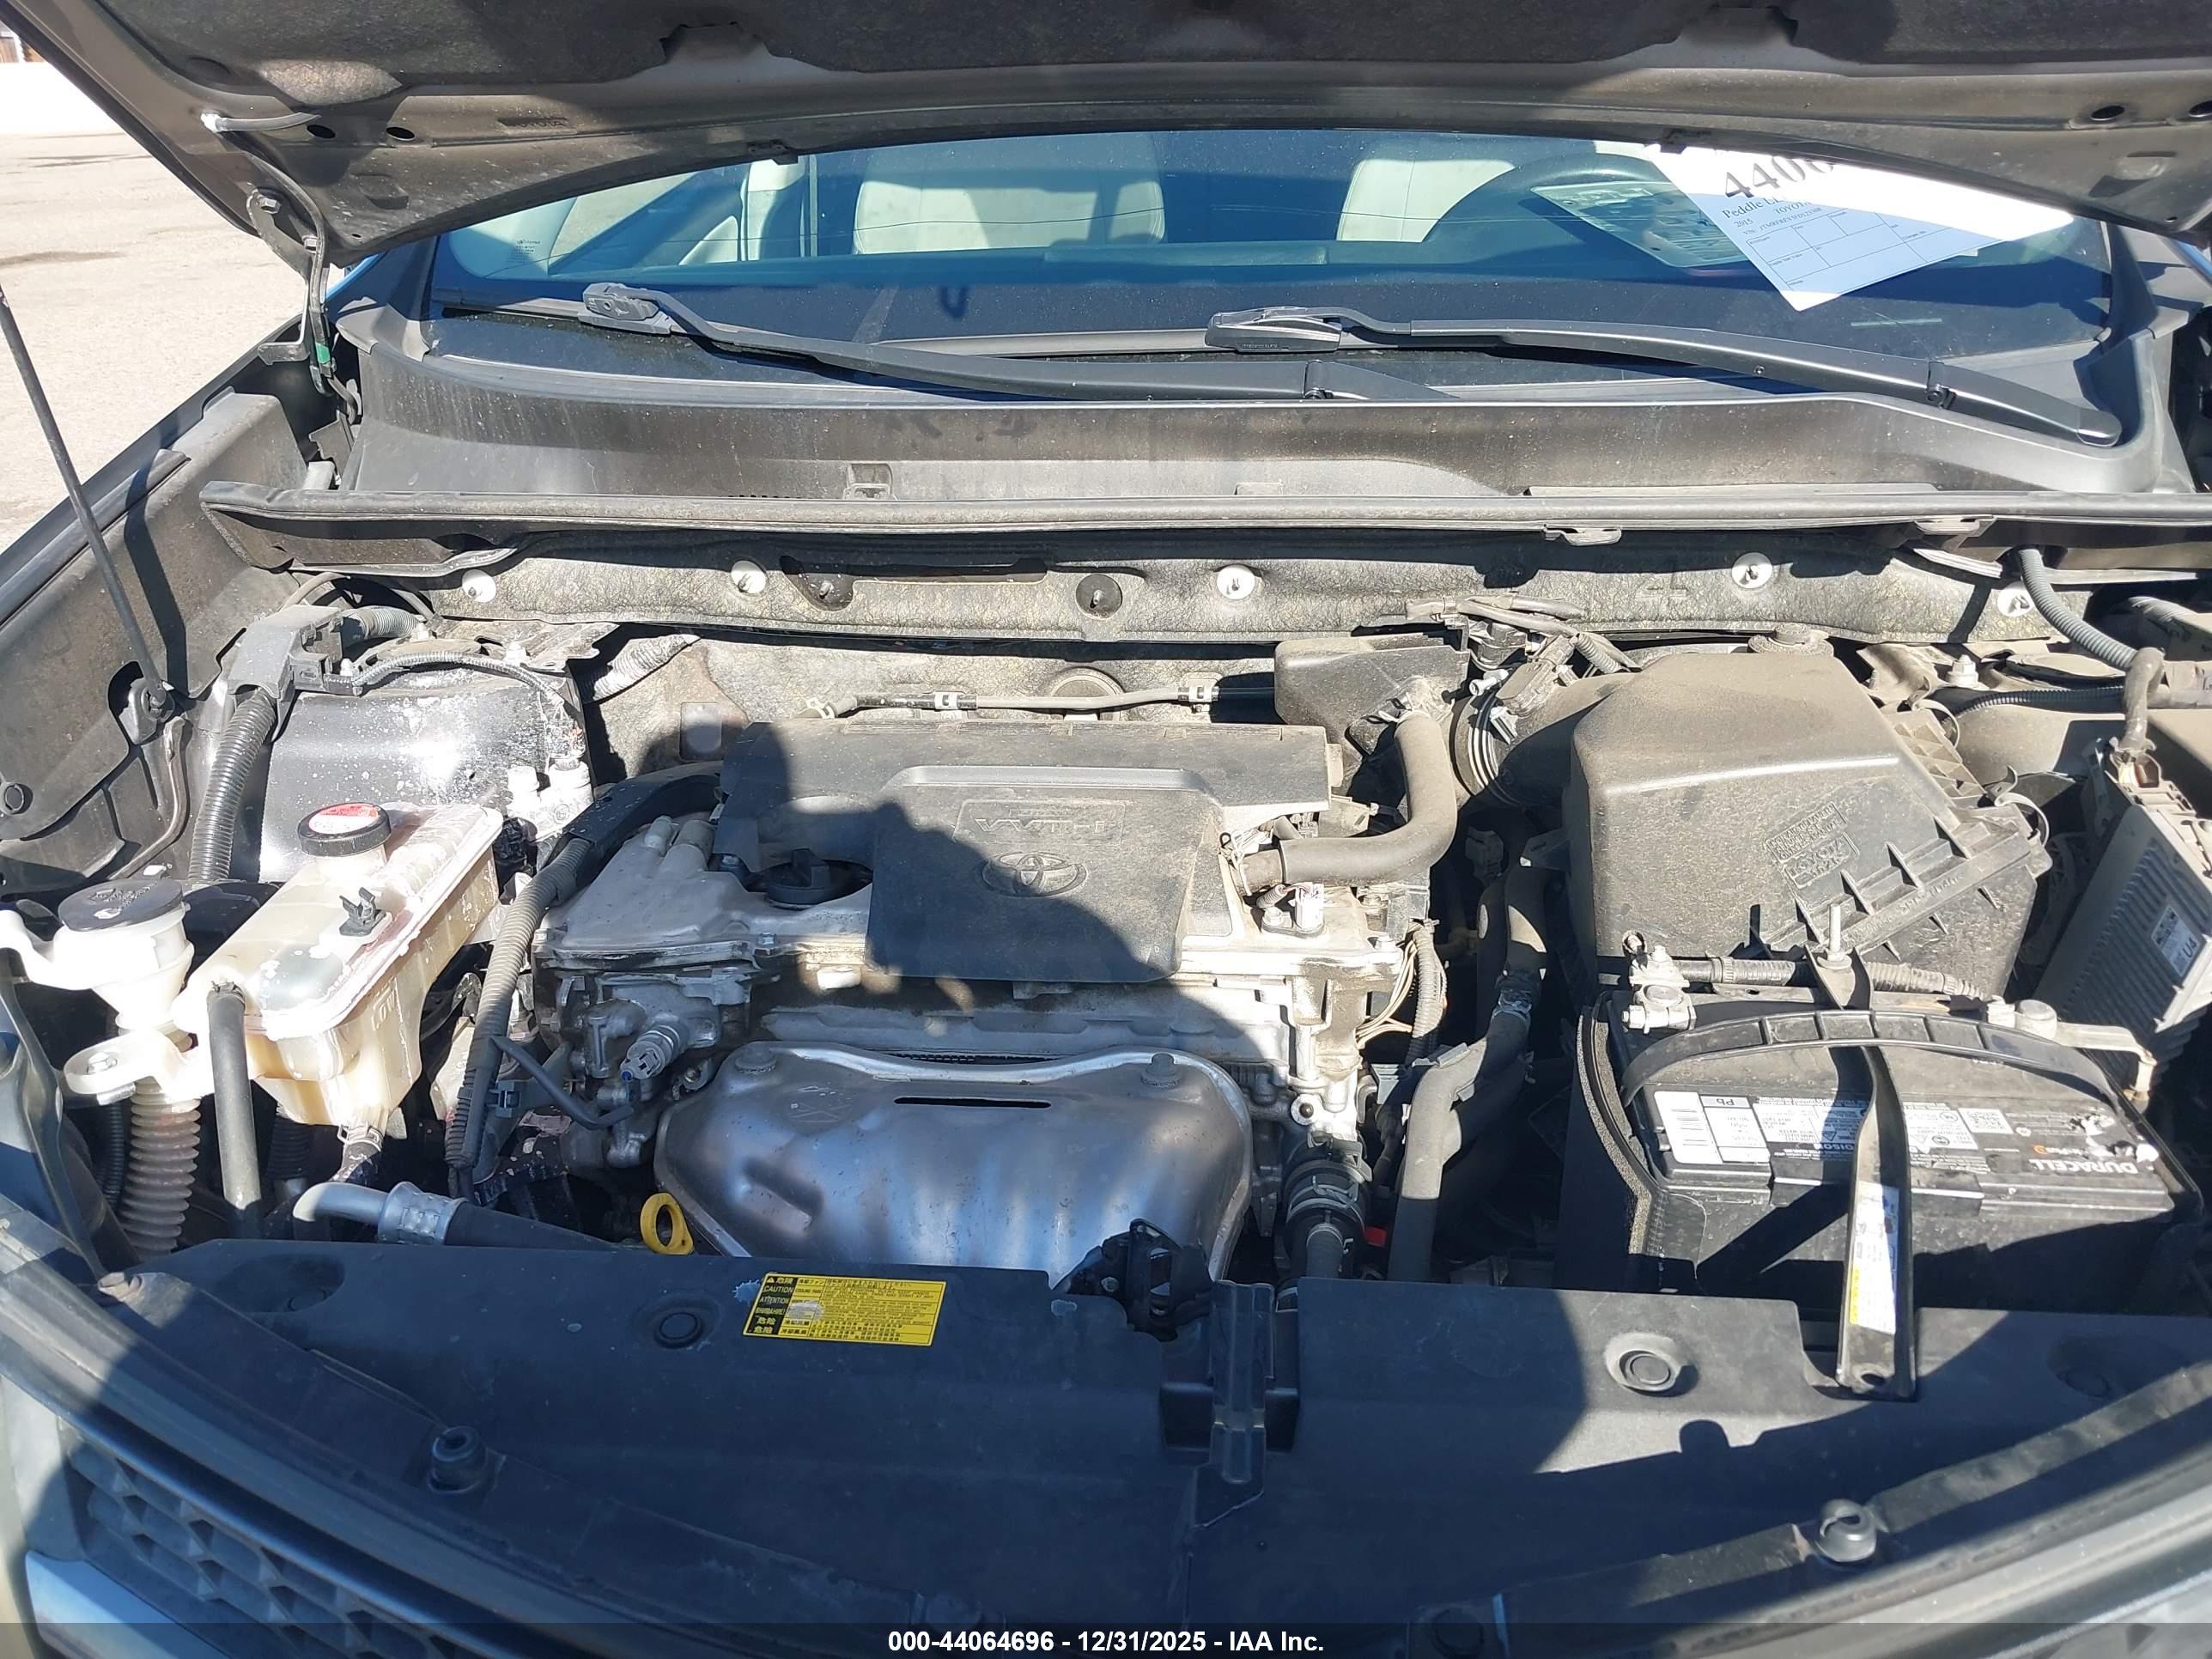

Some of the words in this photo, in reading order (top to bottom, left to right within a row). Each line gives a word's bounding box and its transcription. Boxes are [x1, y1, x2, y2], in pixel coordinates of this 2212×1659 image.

[1722, 200, 1764, 218] Peddle
[1734, 218, 1753, 228] 2015
[2028, 1158, 2138, 1174] DURACELL
[759, 1295, 788, 1304] ATTENTION
